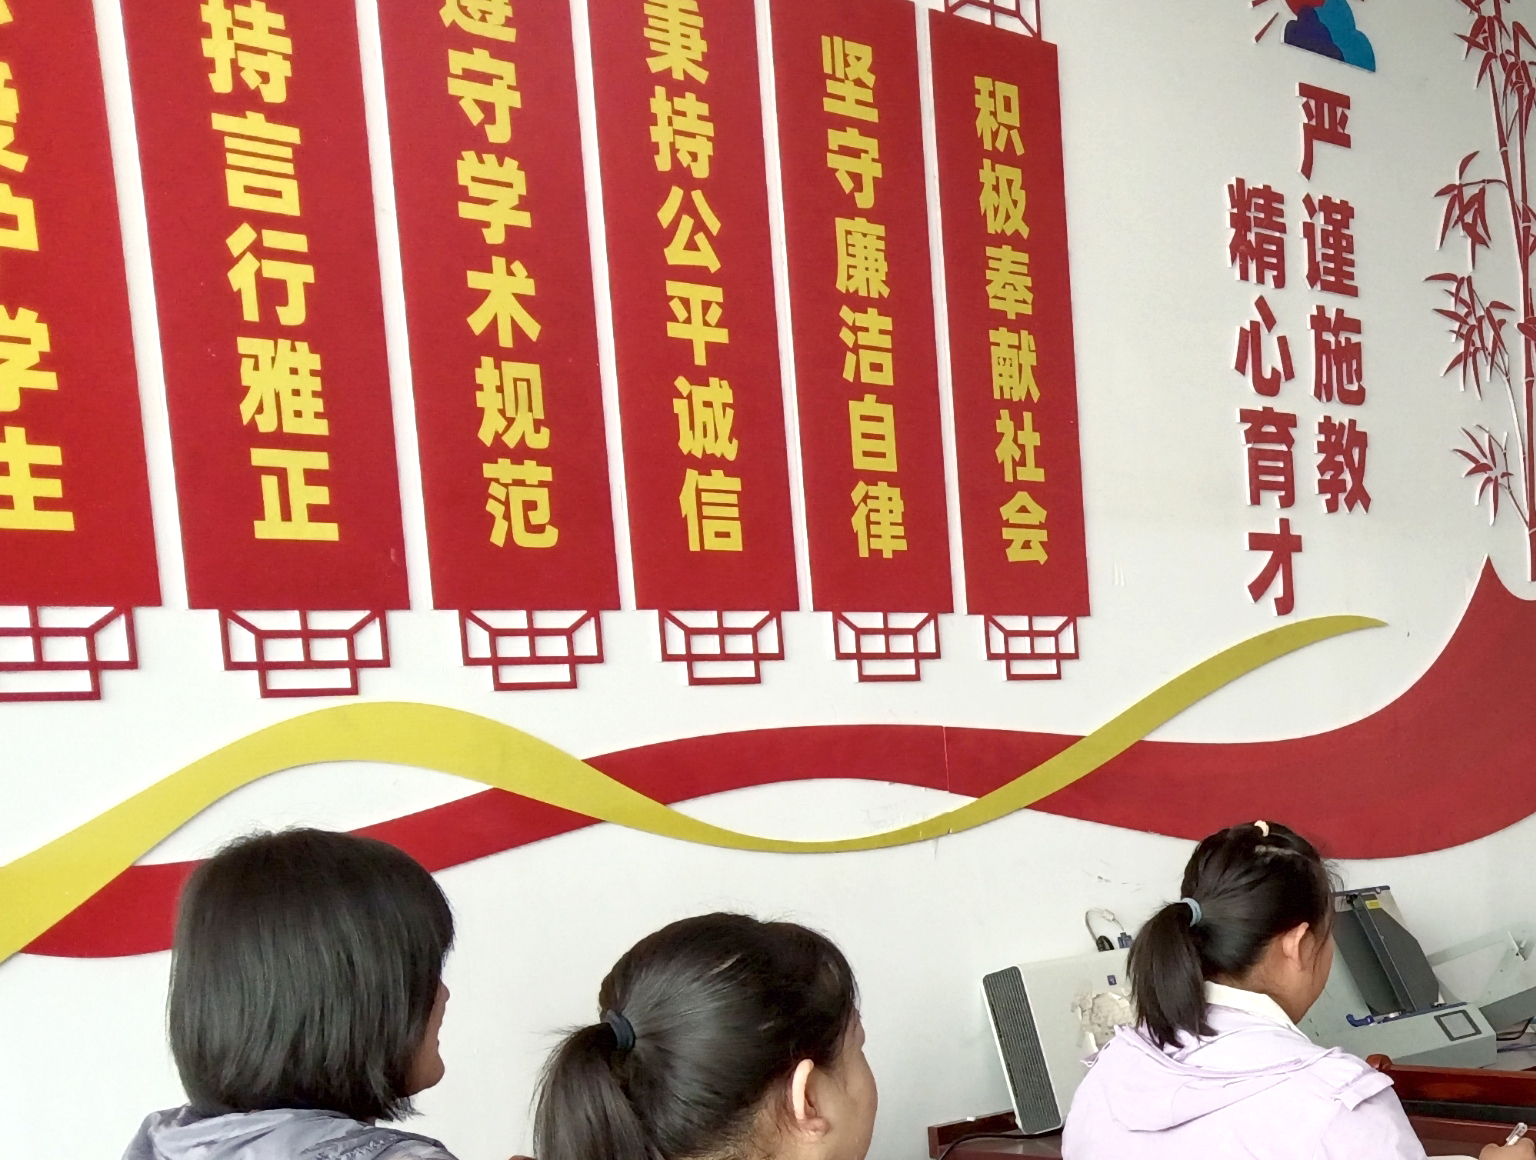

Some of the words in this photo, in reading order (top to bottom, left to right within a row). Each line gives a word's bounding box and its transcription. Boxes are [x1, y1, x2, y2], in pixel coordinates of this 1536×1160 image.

[200, 0, 340, 542] 持言行雅正
[643, 0, 743, 552] 秉持公平诚信
[821, 35, 908, 559] 坚守廉洁自律
[974, 76, 1049, 564] 积极奉献社会
[1228, 178, 1302, 615] 精心育才
[1299, 84, 1371, 514] 严谨施教
